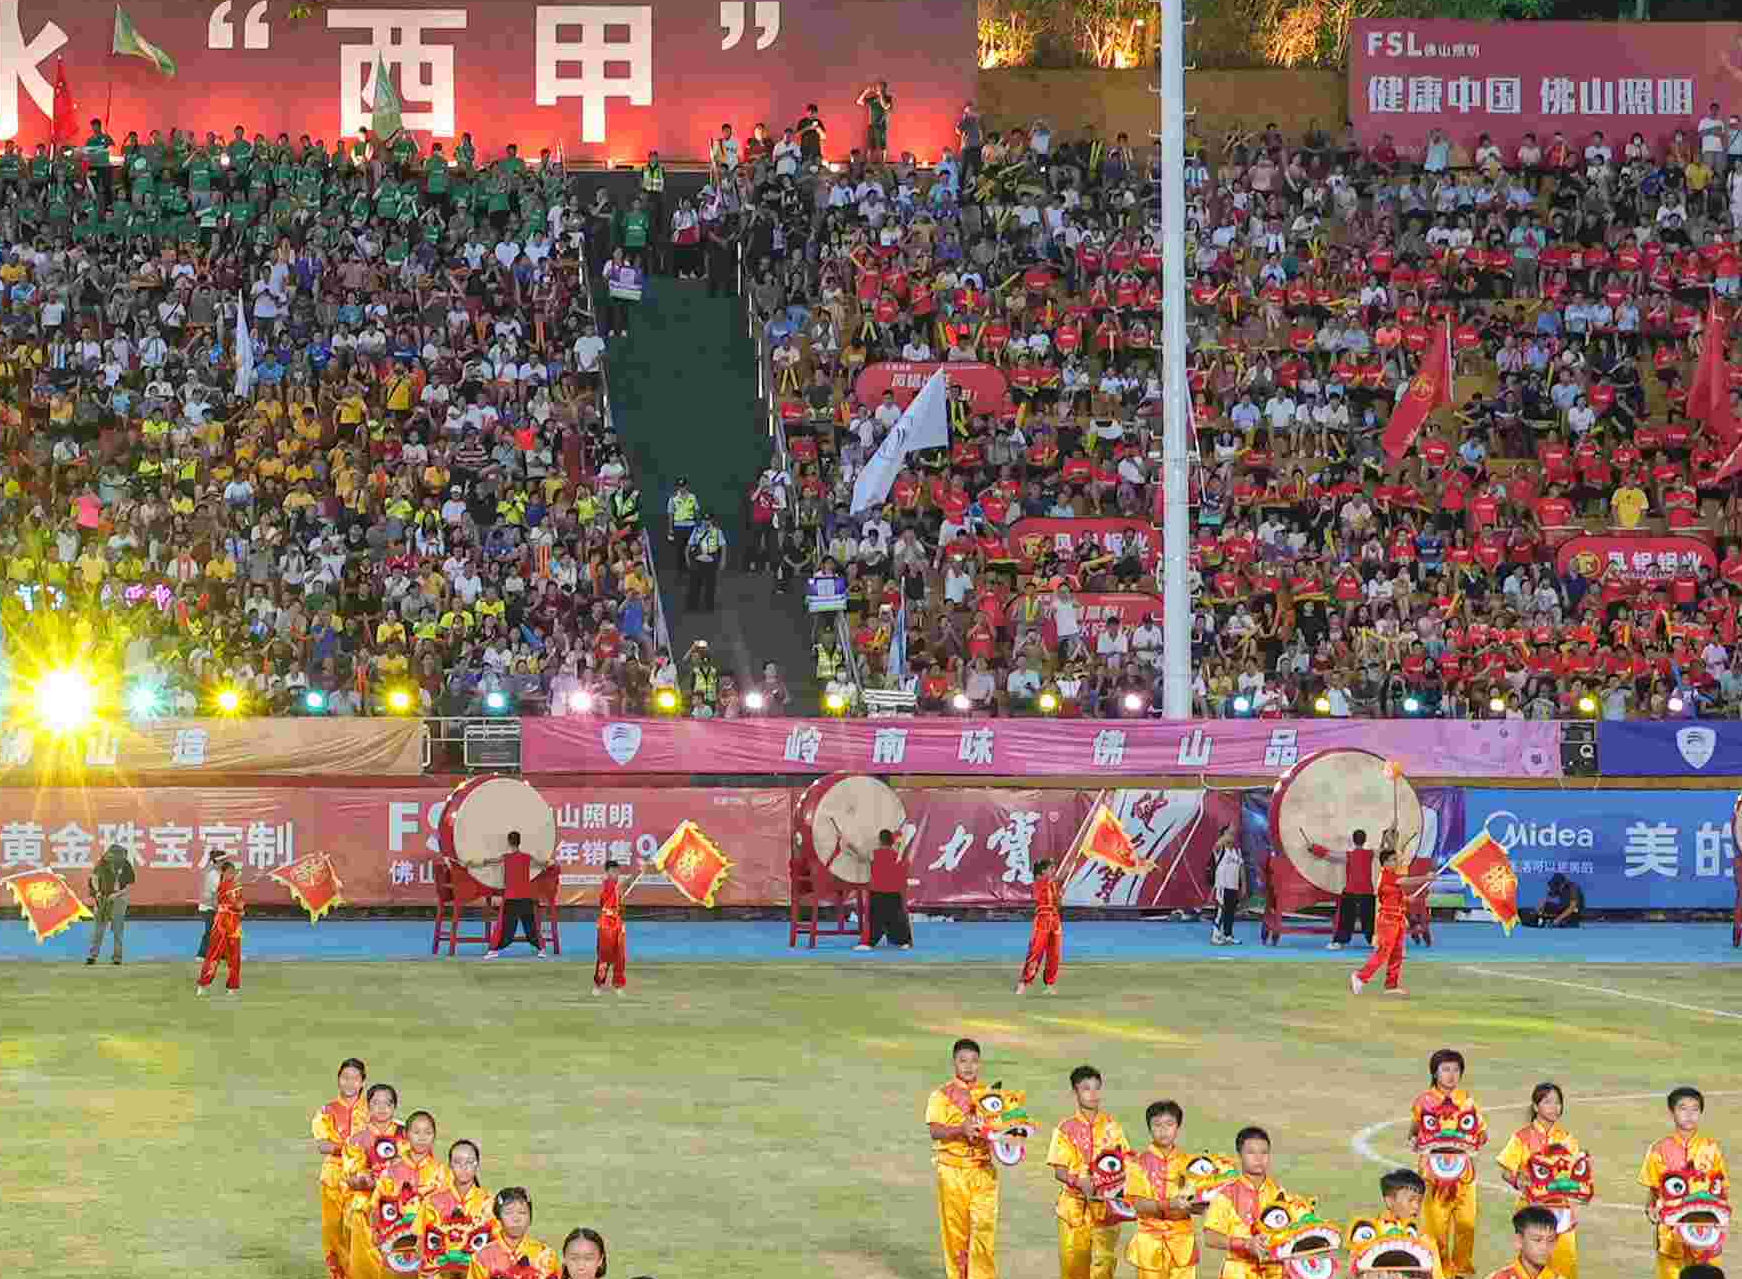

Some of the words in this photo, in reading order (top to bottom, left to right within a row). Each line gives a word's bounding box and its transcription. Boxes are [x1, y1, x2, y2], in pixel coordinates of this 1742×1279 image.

[1367, 32, 1422, 57] FSL
[1368, 76, 1522, 114] 健康中国
[1541, 76, 1693, 114] 佛山照明
[784, 727, 995, 765] 岭南味
[1092, 727, 1300, 765] 佛山品
[554, 802, 634, 828] 山照明
[1500, 822, 1595, 849] Midea
